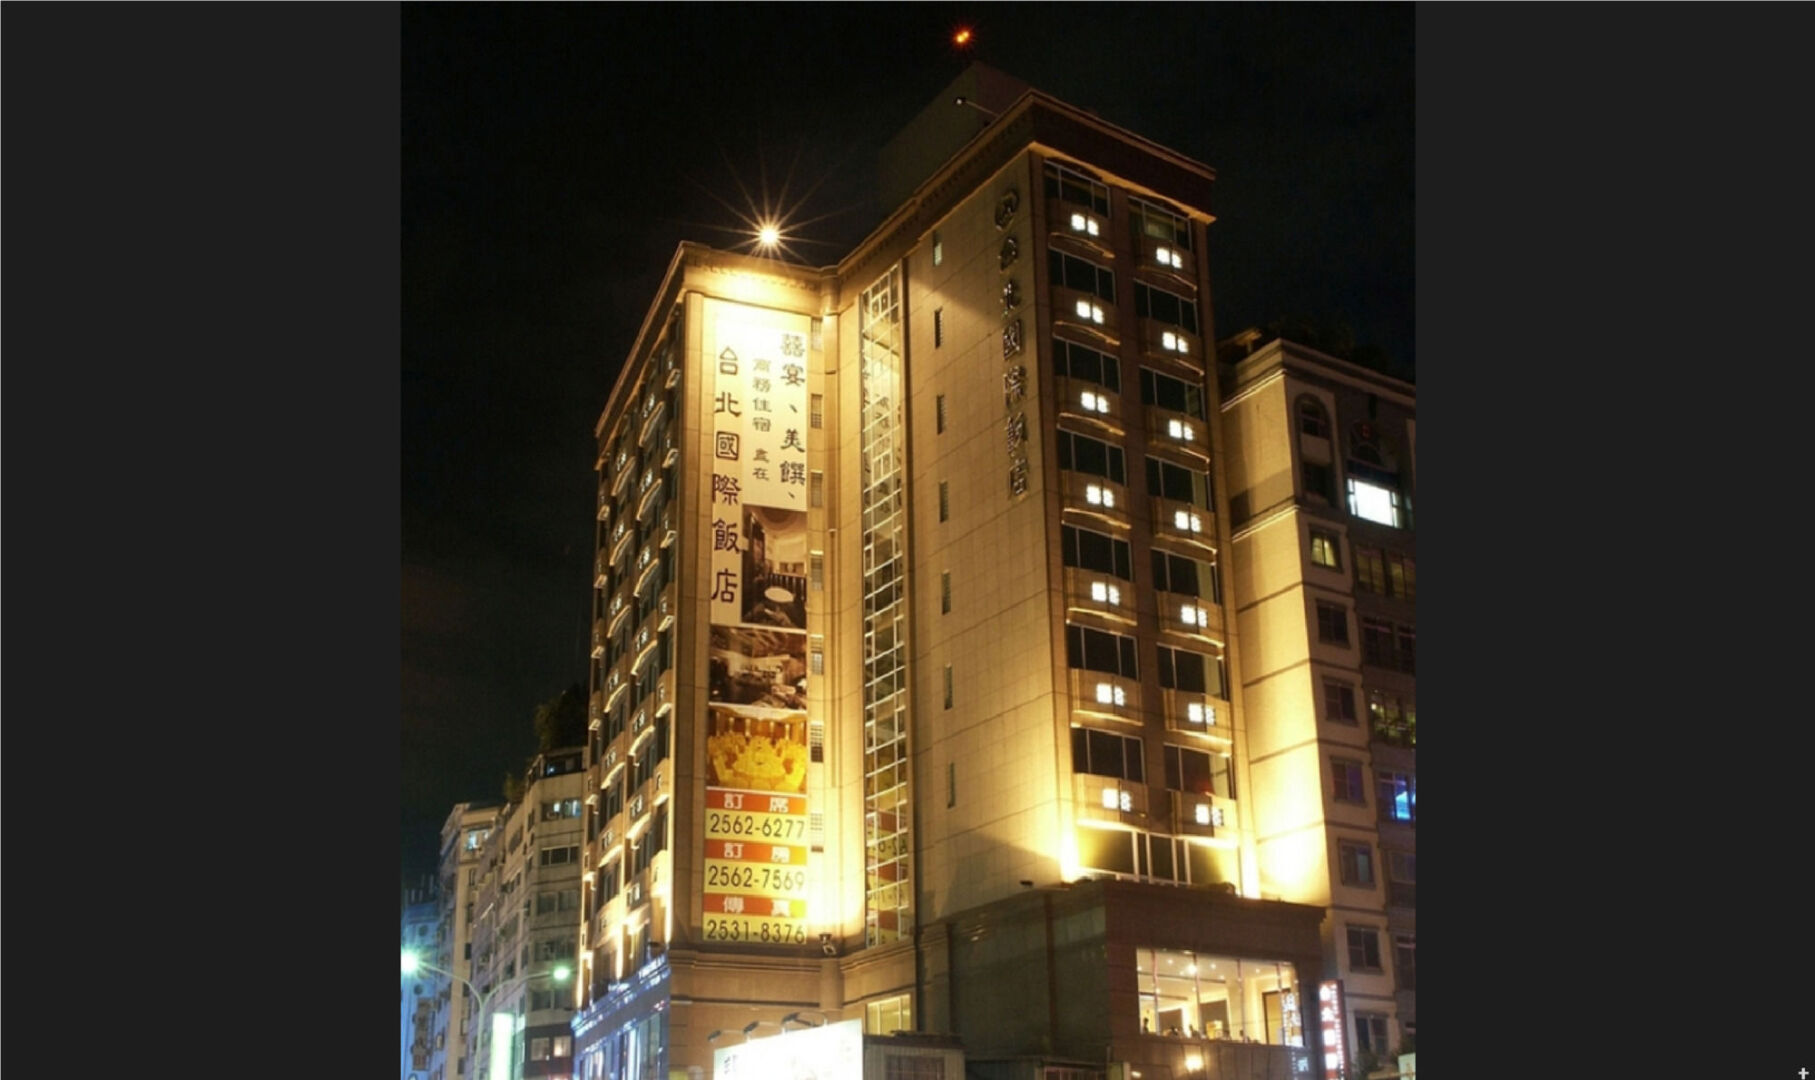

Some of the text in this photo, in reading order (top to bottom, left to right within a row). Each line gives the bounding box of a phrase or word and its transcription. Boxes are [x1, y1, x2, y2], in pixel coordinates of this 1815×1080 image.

[711, 346, 742, 604] 台北國際飯店
[710, 813, 805, 838] 2562-6277
[708, 865, 805, 891] 2562-7569
[707, 920, 805, 944] 2531-8376
